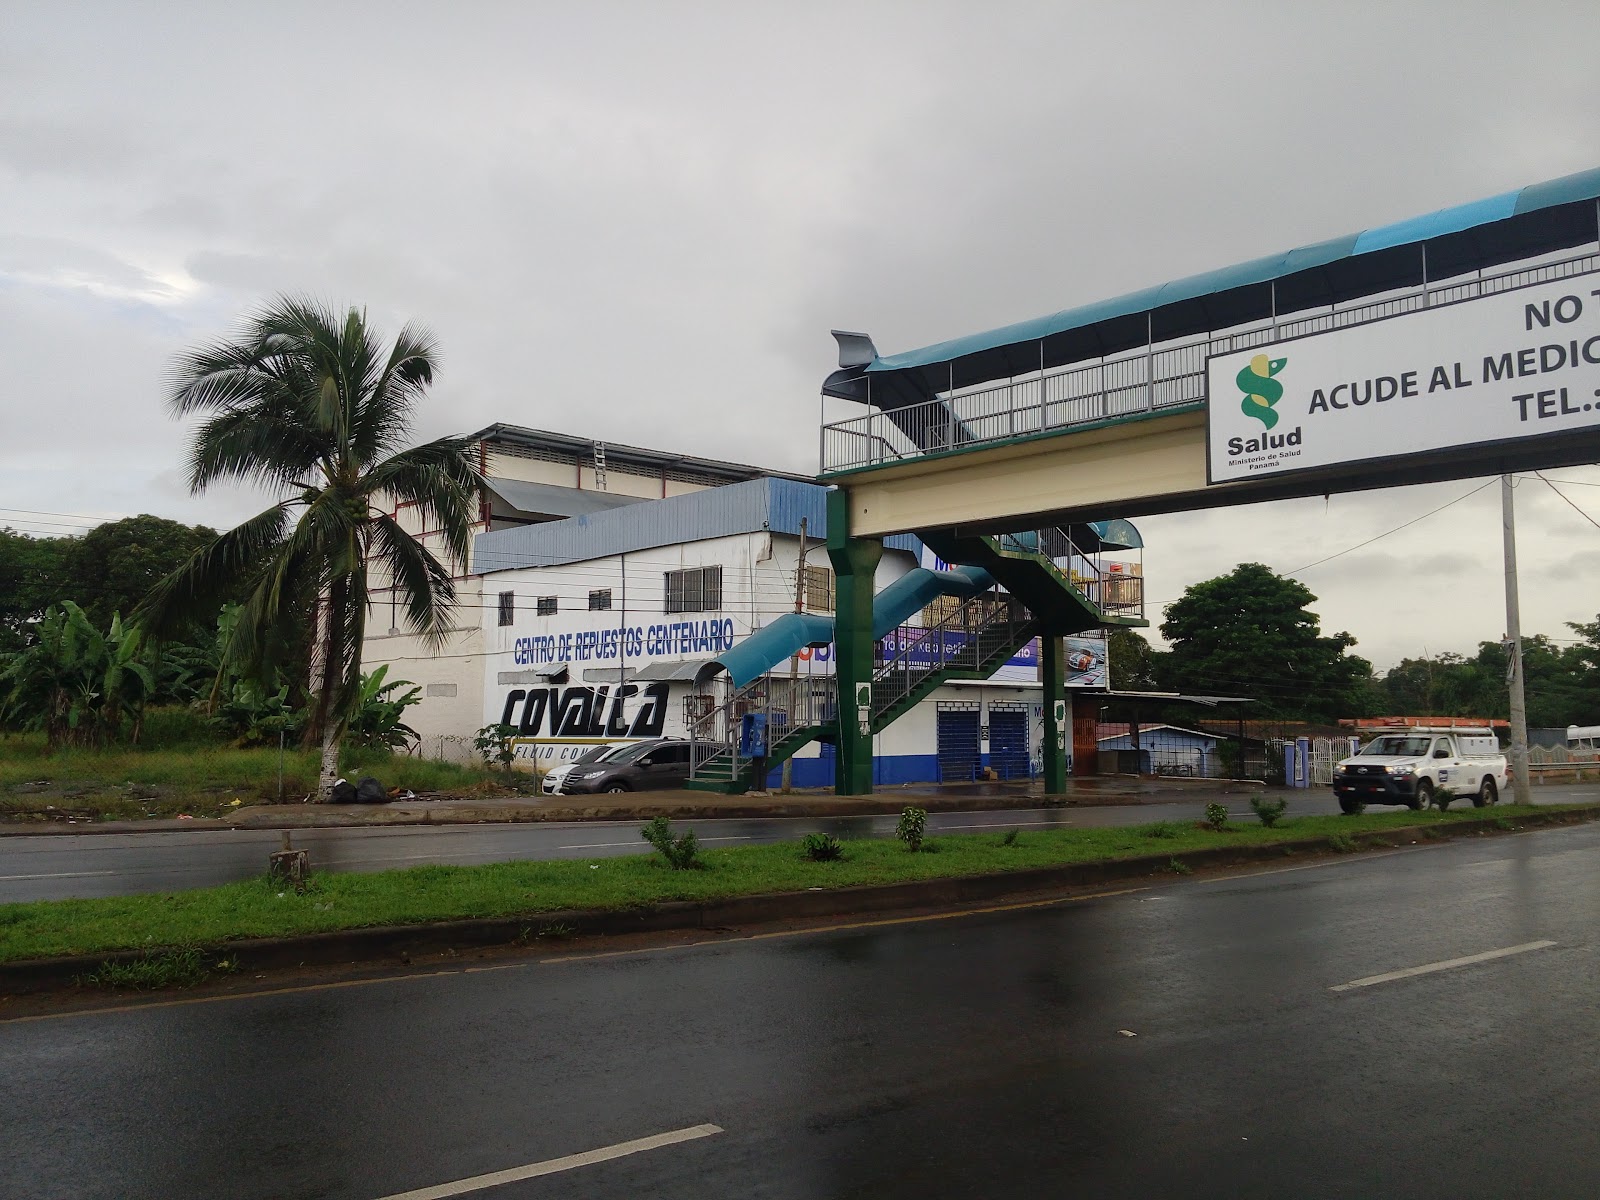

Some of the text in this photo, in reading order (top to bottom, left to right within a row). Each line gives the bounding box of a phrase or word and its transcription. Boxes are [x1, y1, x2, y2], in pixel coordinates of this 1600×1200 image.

[1525, 295, 1583, 331] NO
[1308, 371, 1418, 414] ACUDE
[1428, 363, 1472, 393] AL
[1227, 426, 1302, 455] Salud
[1228, 456, 1266, 466] Ministerio
[1279, 450, 1301, 458] Salud
[1249, 461, 1280, 470] Panamá
[514, 618, 733, 664] CENTRO DE REPUESTOS CENTENARIO
[515, 746, 556, 759] FLUID
